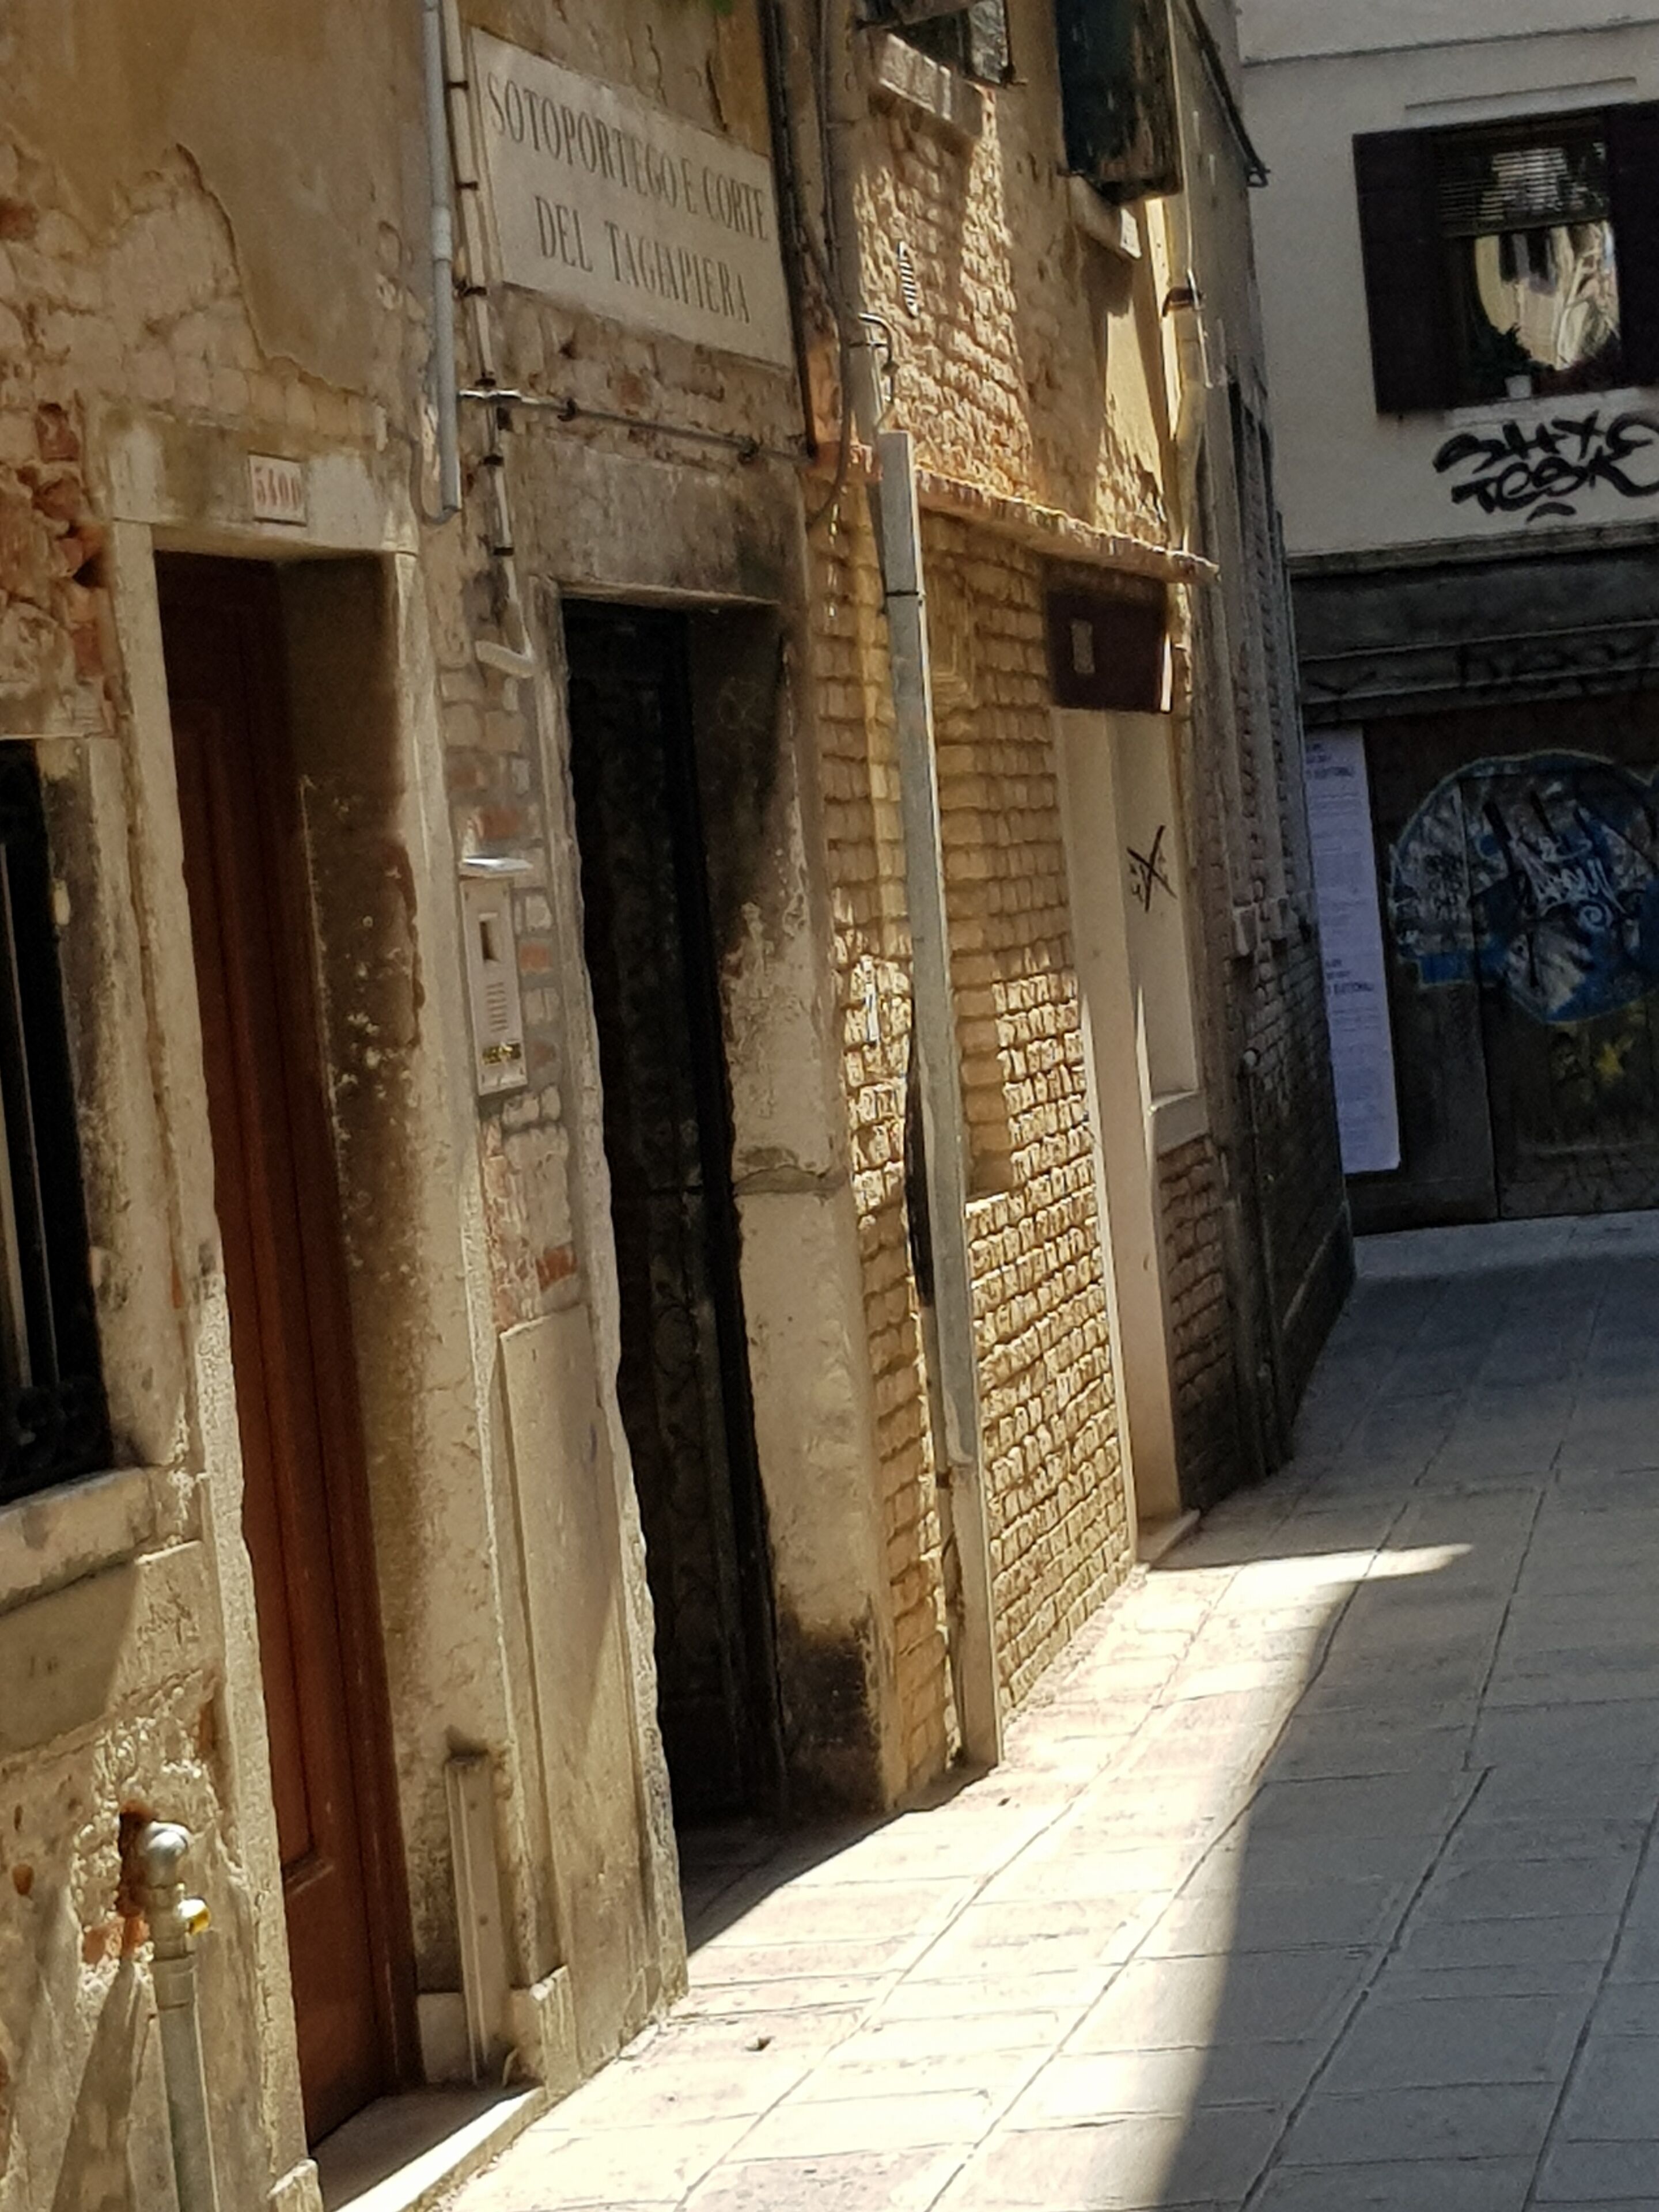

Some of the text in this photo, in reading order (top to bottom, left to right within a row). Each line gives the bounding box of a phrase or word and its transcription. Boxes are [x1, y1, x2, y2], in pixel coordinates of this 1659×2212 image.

[487, 72, 769, 241] SOTOPORTEGO E CORTE
[535, 195, 594, 272] DEL
